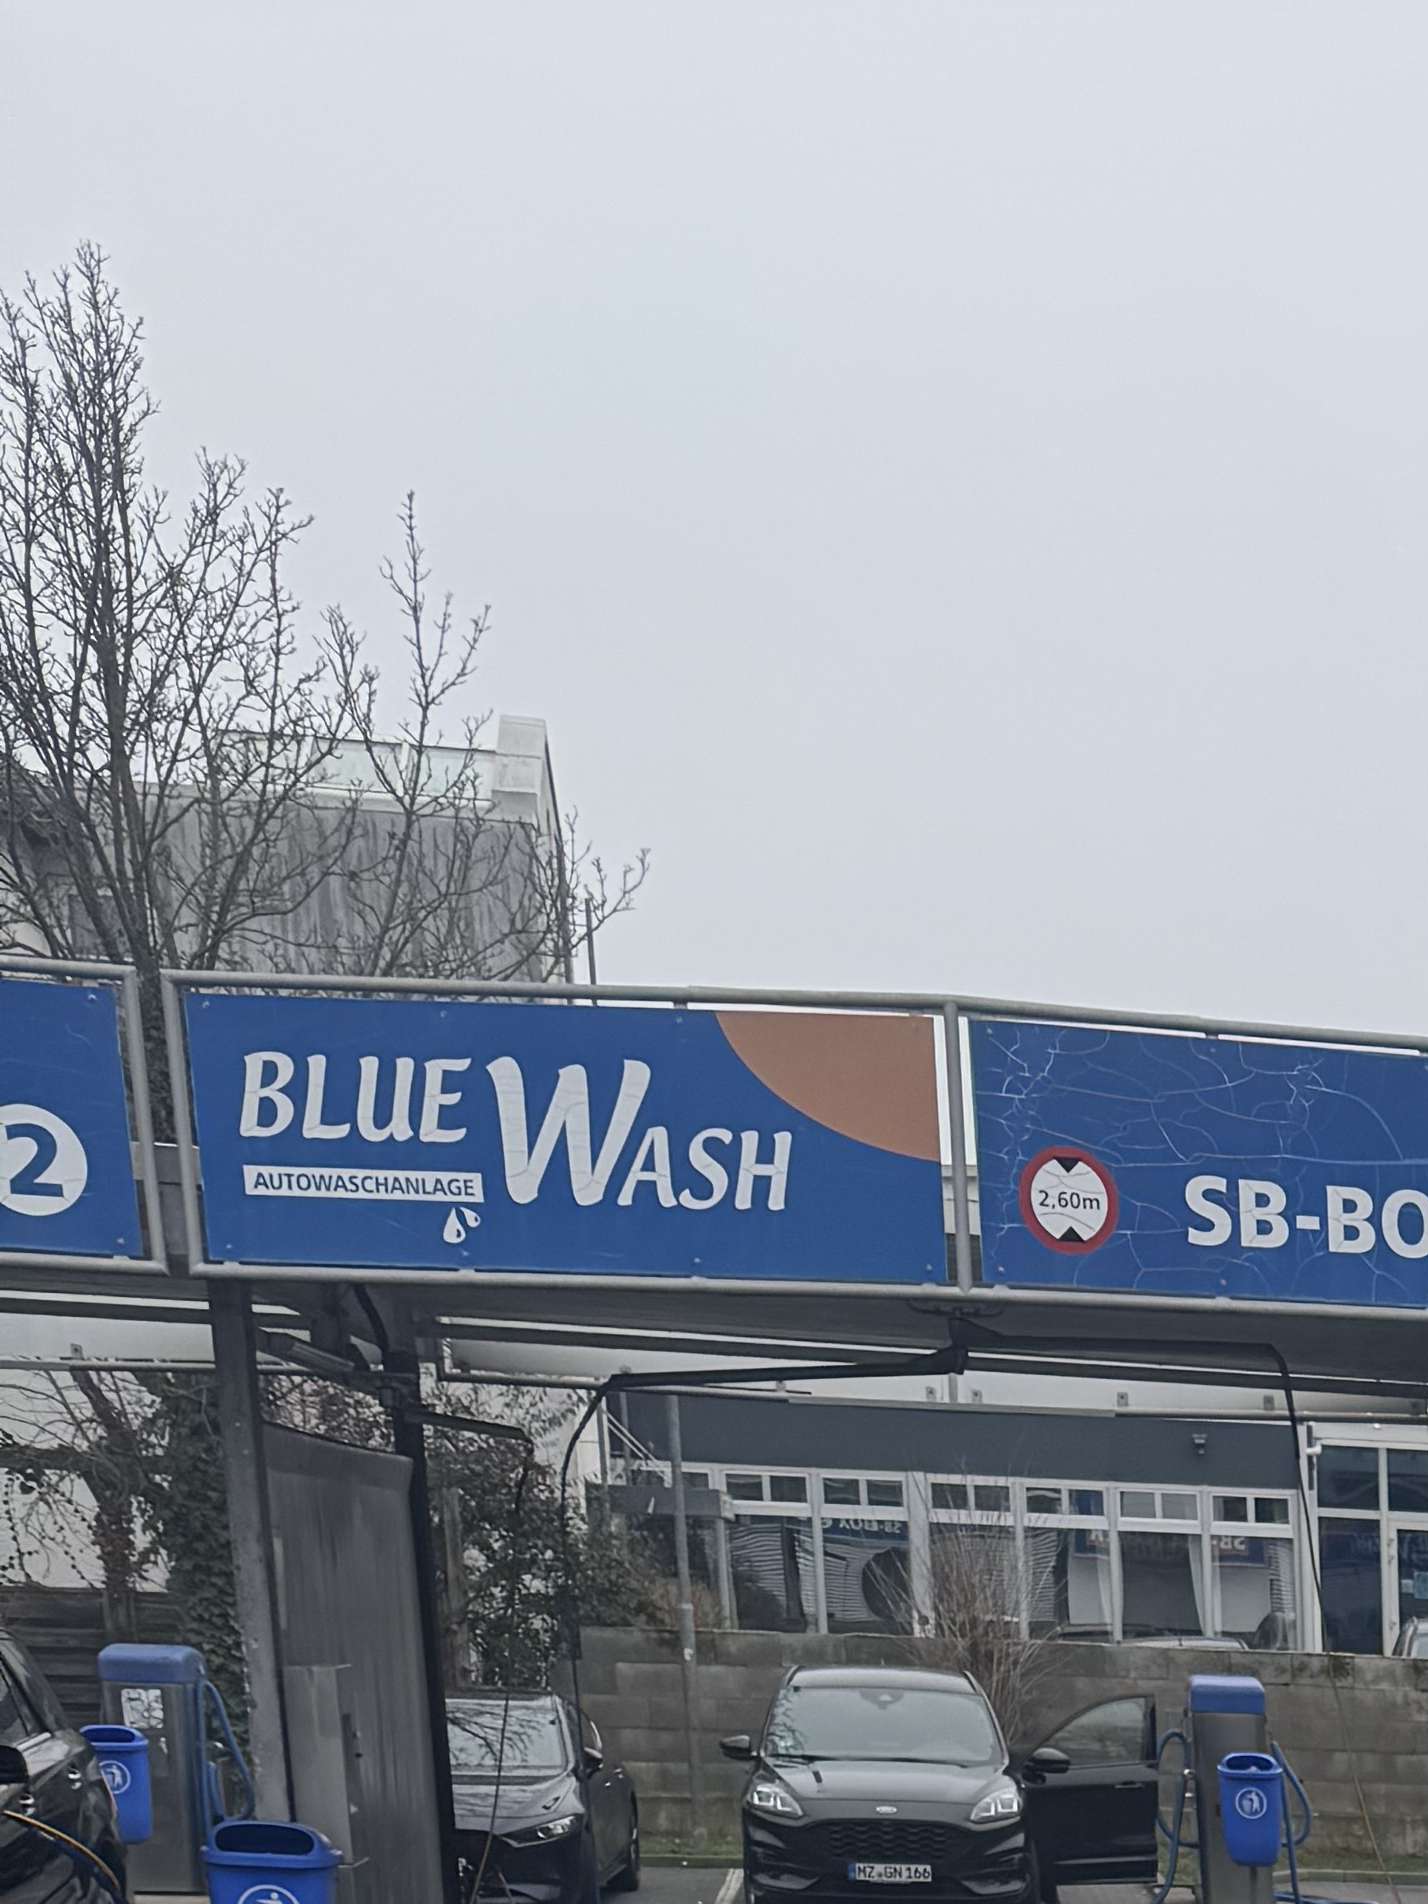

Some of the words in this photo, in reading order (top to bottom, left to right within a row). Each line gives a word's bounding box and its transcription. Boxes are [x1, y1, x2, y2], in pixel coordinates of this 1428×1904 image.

[240, 1052, 471, 1142] BLUE
[486, 1057, 792, 1210] WASH
[5, 1123, 64, 1197] 2
[253, 1171, 476, 1200] AUTOWASCHANLAGE
[1038, 1189, 1101, 1211] 2,60m
[884, 1866, 902, 1879] GN
[905, 1867, 931, 1880] 166
